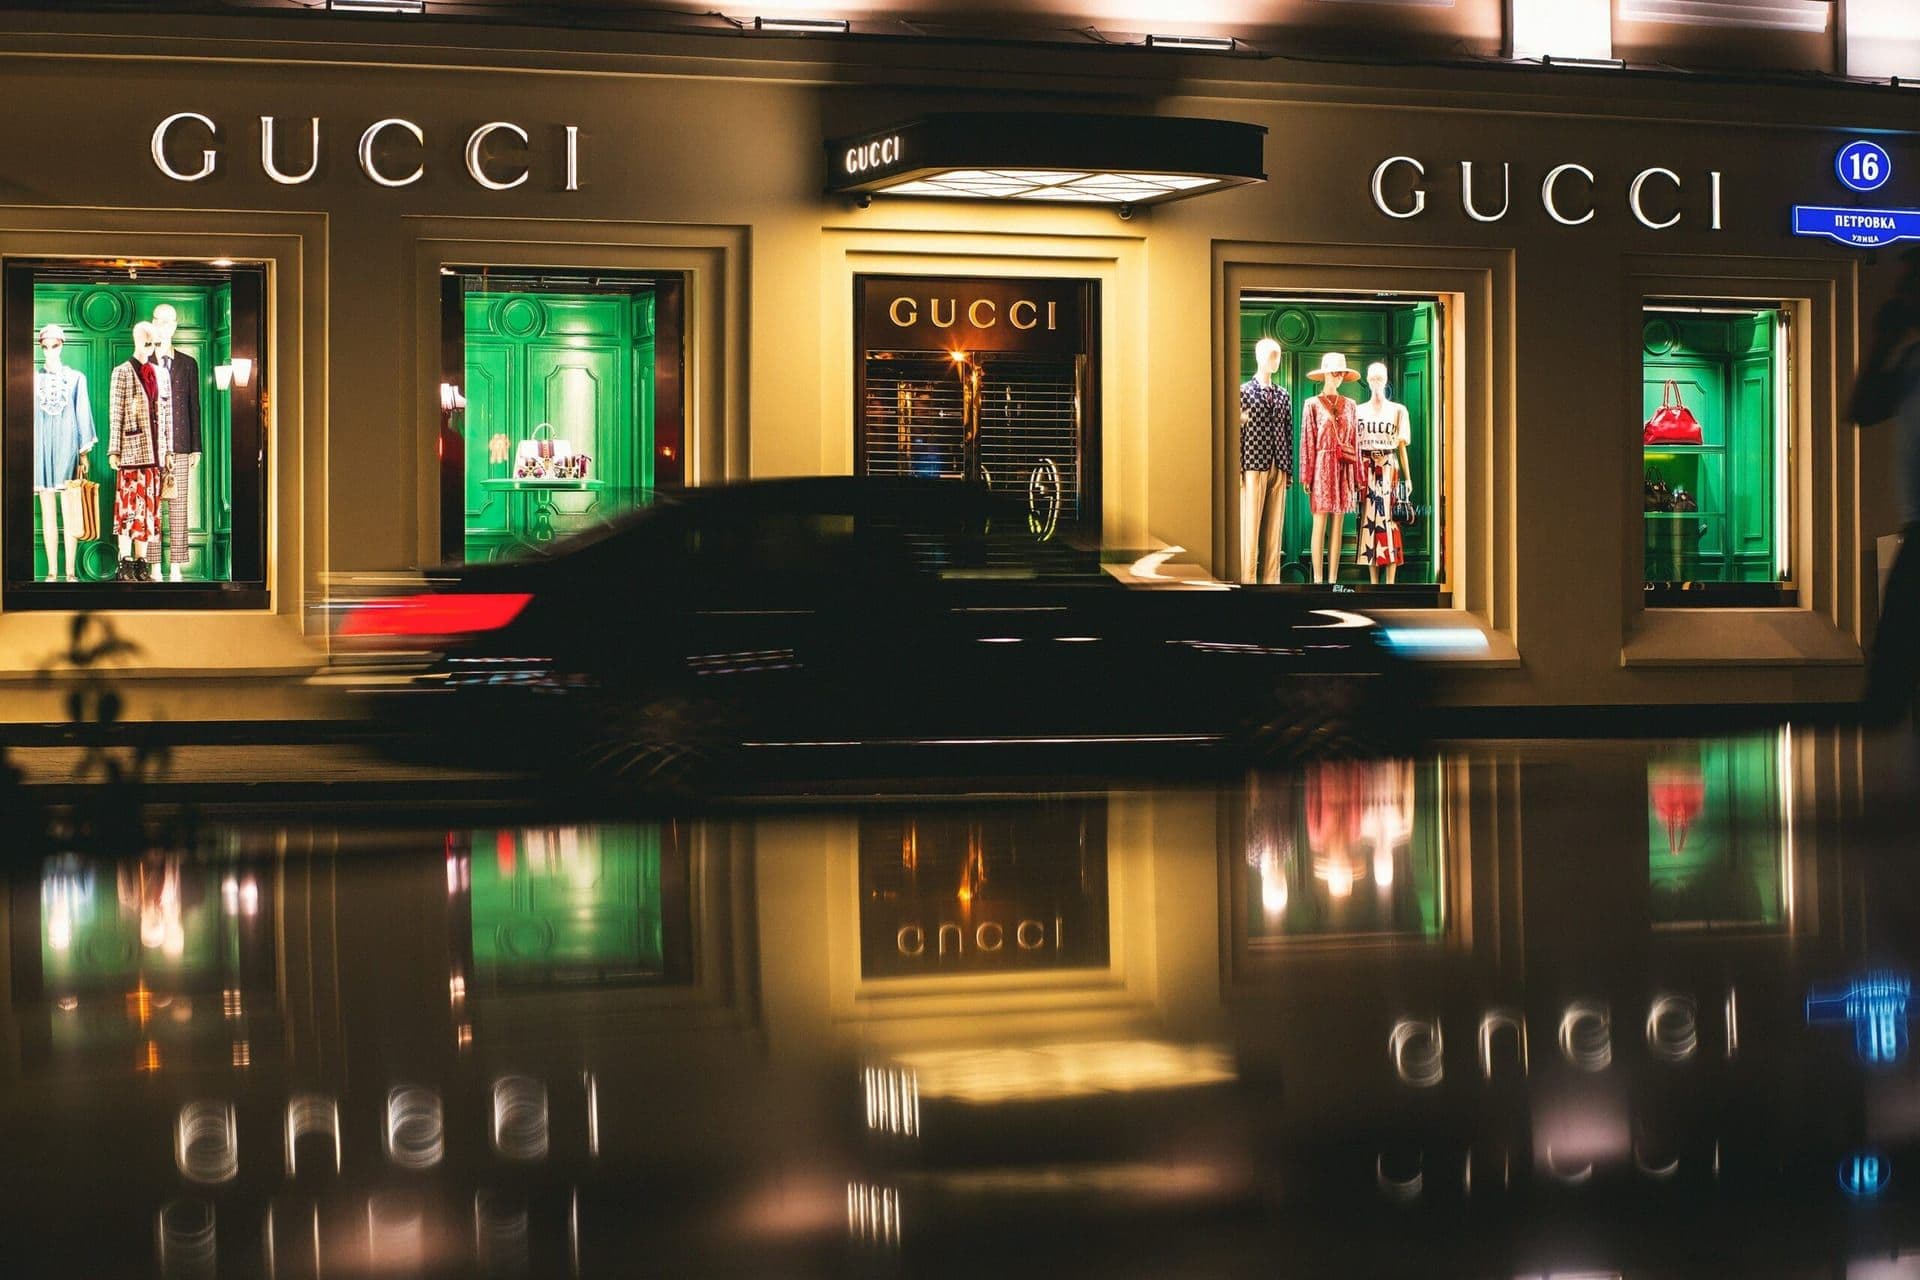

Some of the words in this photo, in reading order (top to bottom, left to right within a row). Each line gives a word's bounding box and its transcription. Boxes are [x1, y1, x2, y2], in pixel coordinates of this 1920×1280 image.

[151, 112, 577, 190] GUCCI
[846, 135, 900, 174] GUCCI
[1850, 152, 1879, 181] 16
[1372, 156, 1721, 230] GUCCI
[1835, 215, 1896, 229] ПЕТРОВКА
[1852, 234, 1879, 243] УЛИЦА
[889, 297, 1057, 330] GUCCI
